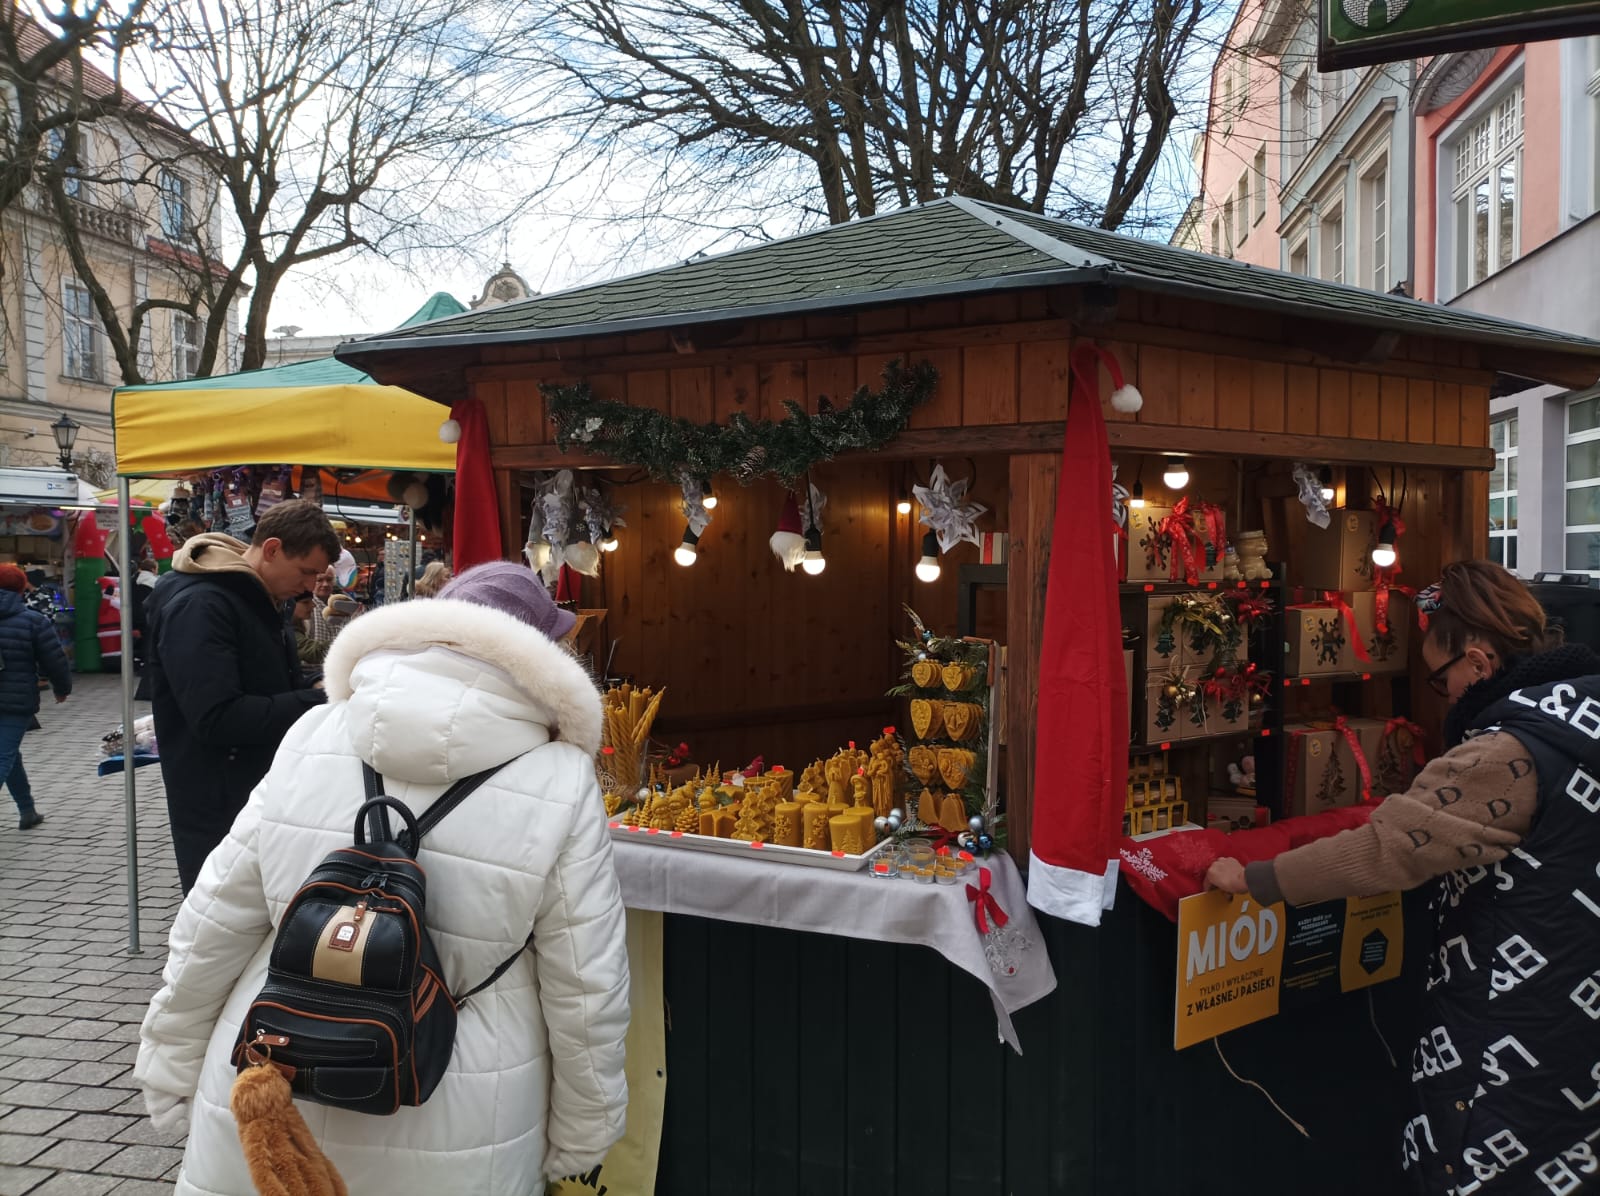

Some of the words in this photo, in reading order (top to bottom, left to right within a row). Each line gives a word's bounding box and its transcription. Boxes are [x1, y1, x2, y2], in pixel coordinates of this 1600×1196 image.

[1509, 758, 1532, 779] D
[1435, 786, 1462, 807] D
[1487, 798, 1512, 819] D
[1406, 828, 1432, 848] D
[1186, 900, 1278, 984] MIÓD
[1187, 1003, 1193, 1017] Z
[1195, 989, 1239, 1013] WŁASNEJ
[1240, 976, 1275, 998] PASIEKI
[1200, 982, 1221, 997] TYLKO
